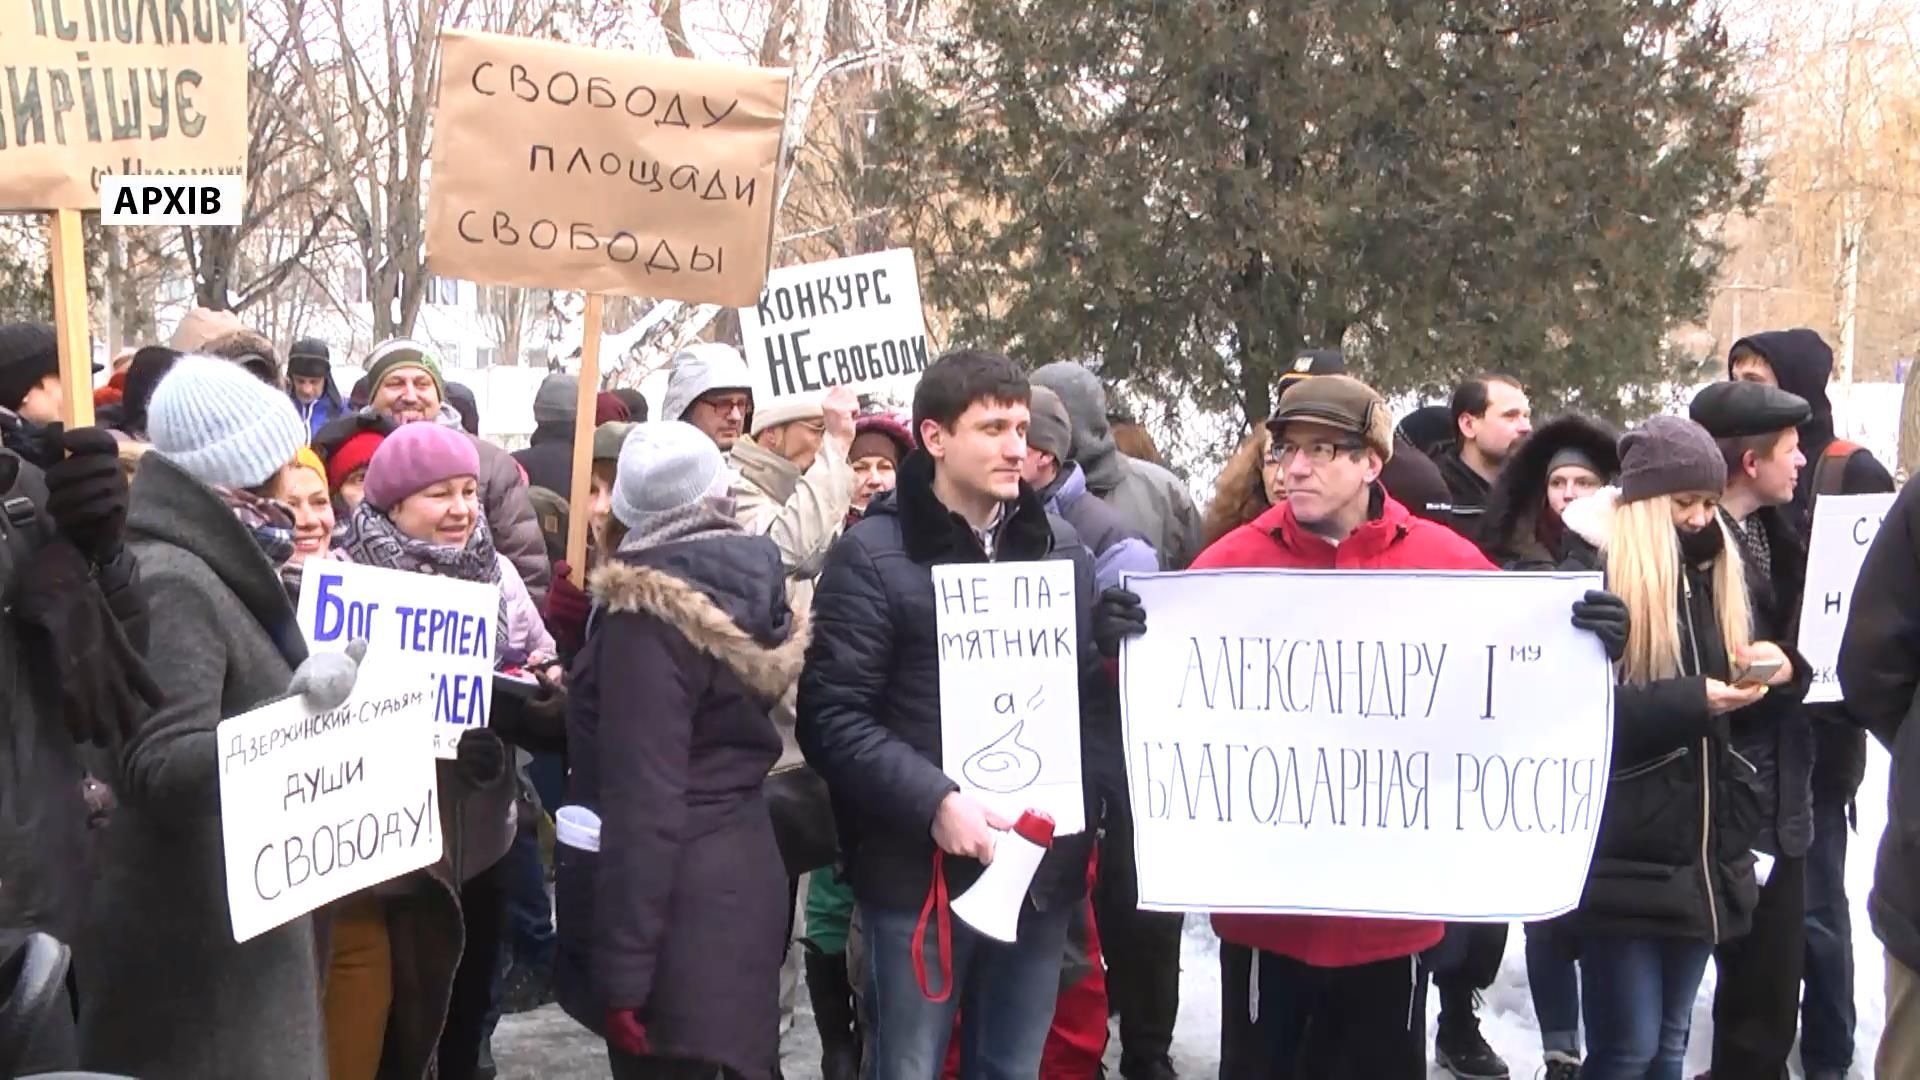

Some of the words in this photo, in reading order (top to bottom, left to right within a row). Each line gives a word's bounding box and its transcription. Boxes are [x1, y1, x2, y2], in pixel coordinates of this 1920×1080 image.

[472, 61, 738, 129] СВОБОДУ
[530, 144, 756, 206] ПЛОЩАДИ
[458, 210, 723, 274] СВОБОДЫ
[757, 268, 892, 327] КОНКУРС
[941, 578, 989, 615] НЕ
[1014, 576, 1071, 609] ПА-
[396, 606, 488, 659] ТЕРПЕЛ
[941, 627, 1072, 661] МЯТНИК
[431, 672, 487, 728] ЛЕЛ
[1178, 637, 1448, 720] АЛЕКСАНДРУ
[284, 756, 364, 811] ДУШИ
[1143, 741, 1430, 831] БЛАГОДАРНАЯ
[1455, 751, 1597, 835] РОССІЯ
[254, 788, 433, 901] СВОБОДУ!
